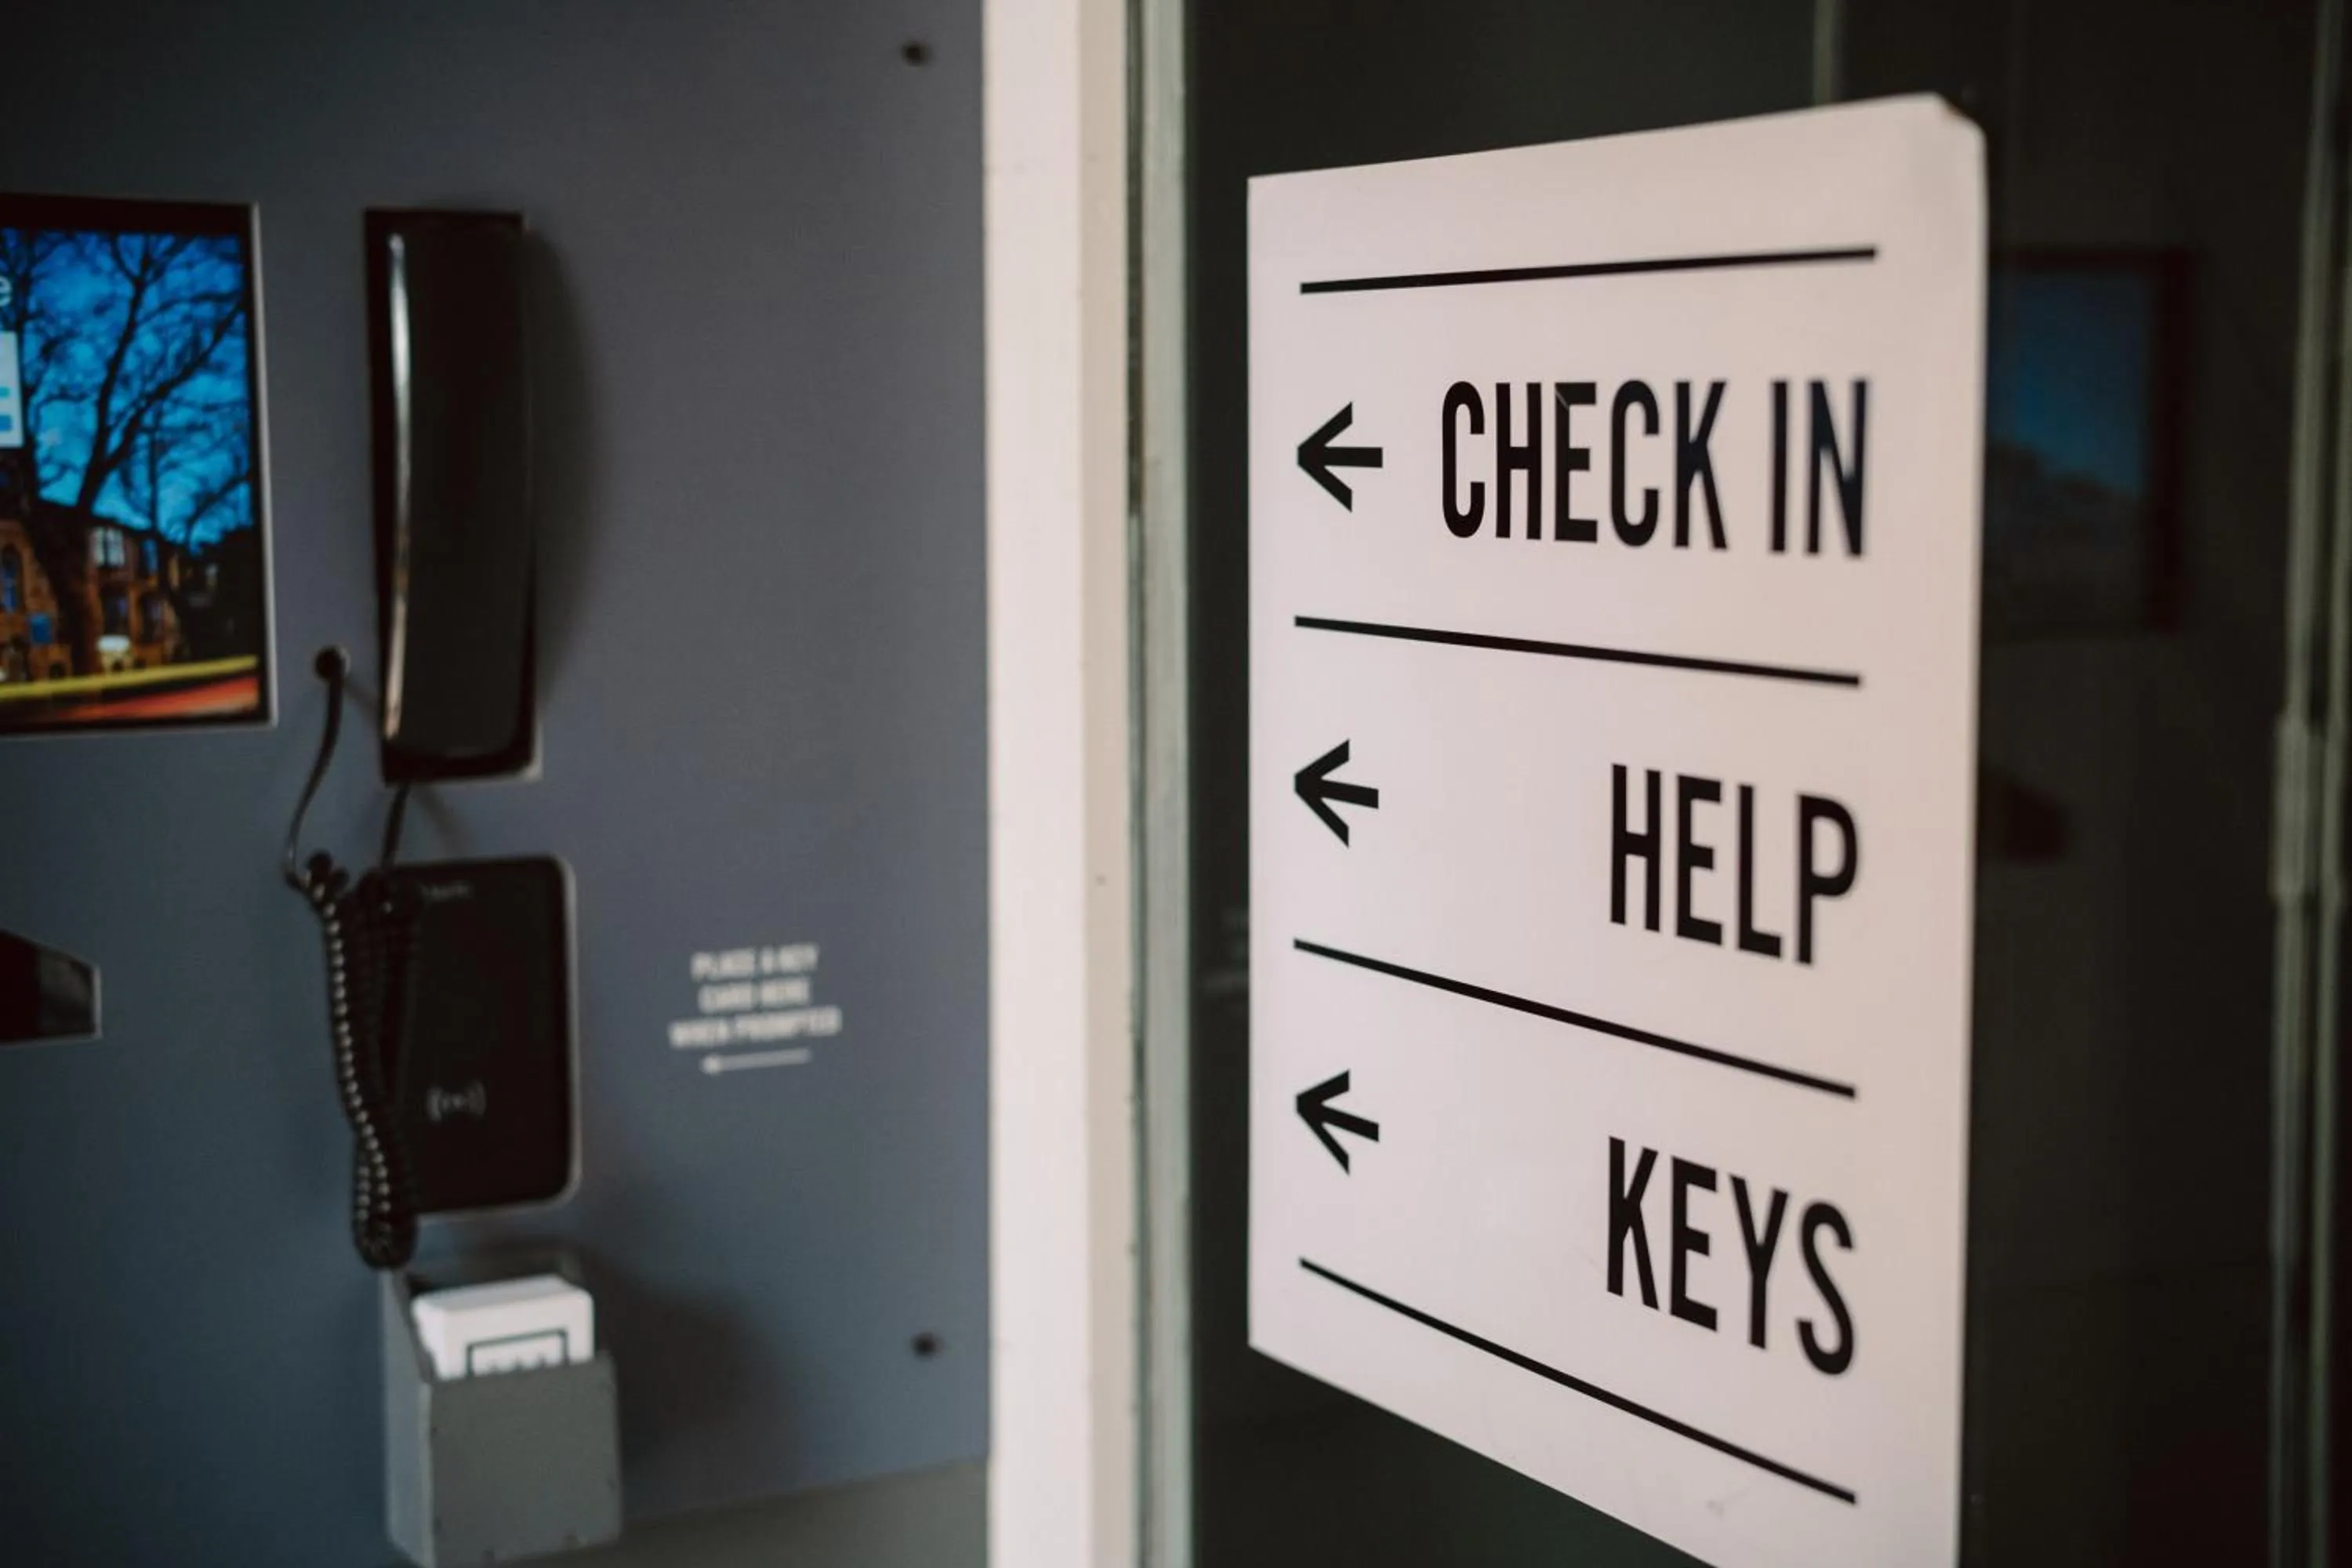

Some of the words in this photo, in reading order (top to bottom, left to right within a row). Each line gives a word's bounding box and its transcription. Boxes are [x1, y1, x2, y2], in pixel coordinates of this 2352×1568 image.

[1441, 379, 1728, 550] CHECK
[1769, 378, 1868, 557] IN
[1610, 763, 1859, 965] HELP
[1606, 1135, 1856, 1376] KEYS
